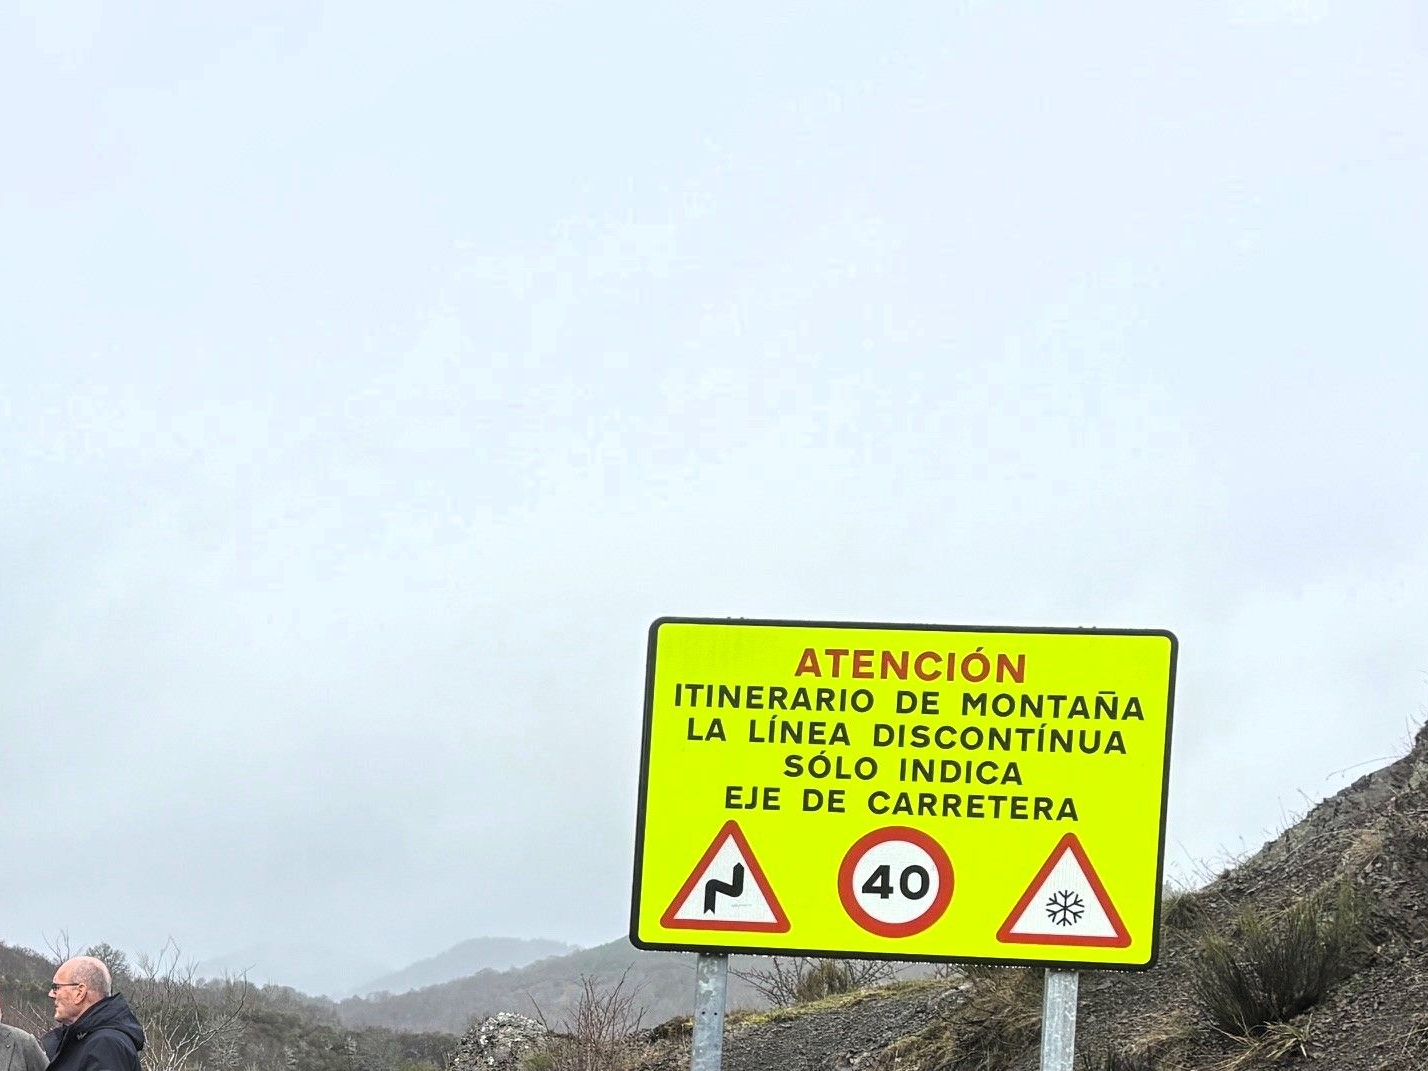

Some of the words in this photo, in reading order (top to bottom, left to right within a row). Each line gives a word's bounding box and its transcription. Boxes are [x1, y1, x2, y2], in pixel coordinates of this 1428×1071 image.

[795, 647, 1025, 683] ATENCIÓN
[675, 684, 873, 712] ITINERARIO
[896, 691, 939, 714] DE
[962, 691, 1144, 720] MONTAÑA
[688, 718, 726, 741] LA
[749, 715, 850, 745] LÍNEA
[874, 724, 1126, 754] DISCONTÍNUA
[784, 751, 877, 780] SÓLO
[900, 759, 1022, 785] INDICA
[726, 786, 780, 810] EJE
[803, 789, 845, 812] DE
[868, 791, 1078, 821] CARRETERA
[862, 865, 929, 900] 40
